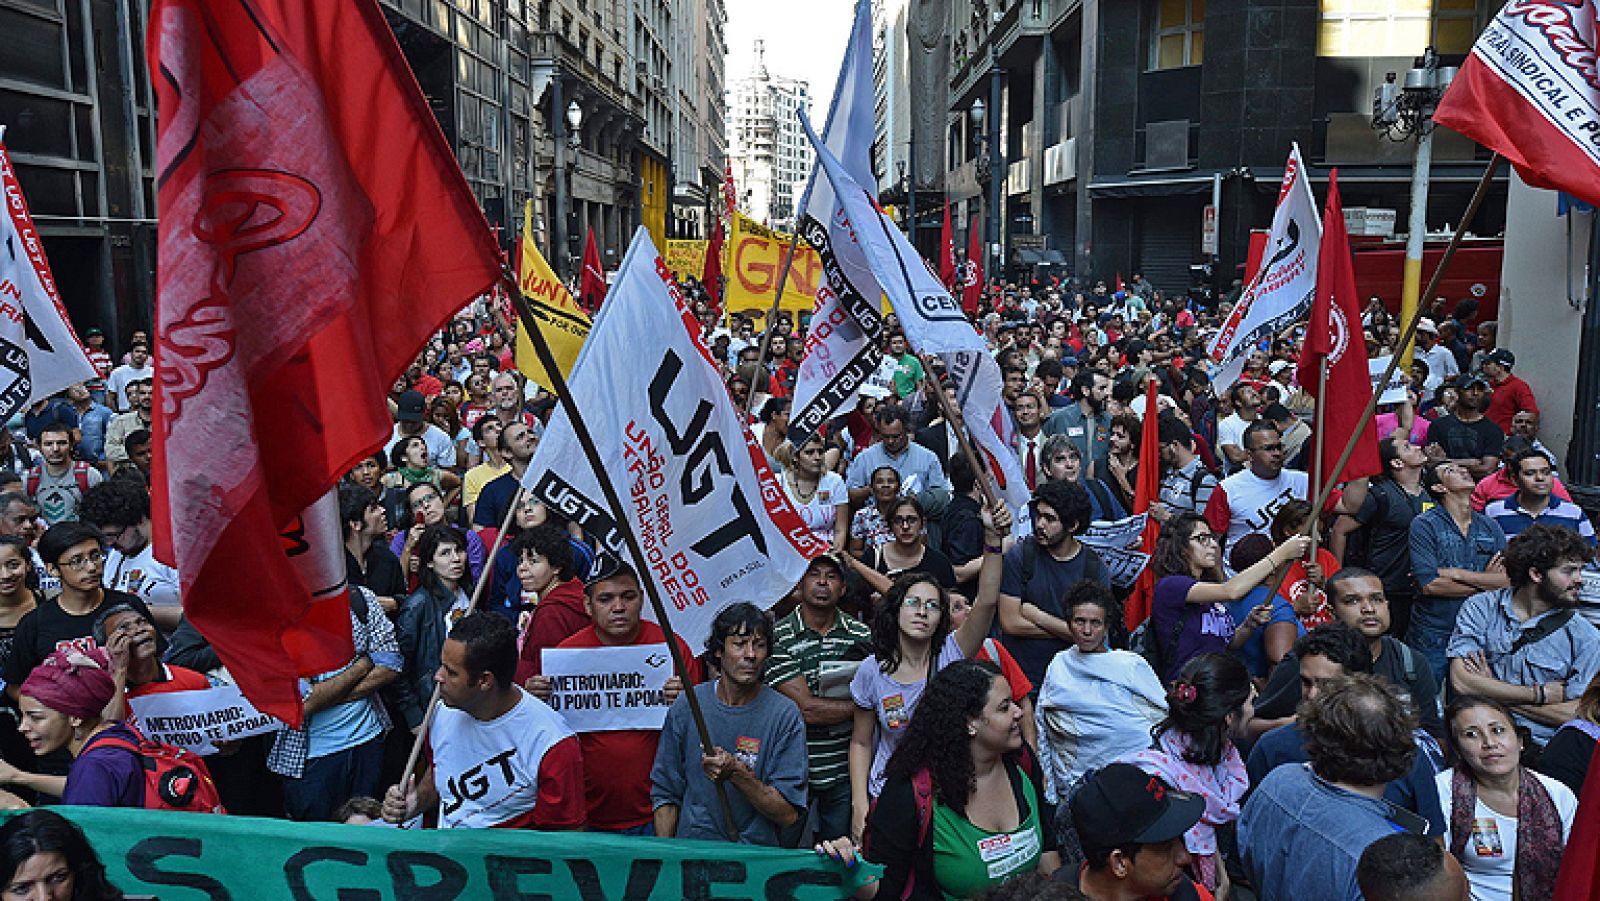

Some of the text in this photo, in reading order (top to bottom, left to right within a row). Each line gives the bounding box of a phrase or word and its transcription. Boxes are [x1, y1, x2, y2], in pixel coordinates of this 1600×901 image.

[1506, 47, 1570, 109] SINDICAL
[1565, 107, 1587, 122] E
[6, 184, 28, 223] UGT
[22, 228, 46, 267] UGT
[826, 258, 853, 299] UGT
[648, 347, 769, 559] UGT
[544, 480, 599, 525] UGT
[758, 466, 825, 556] UGT UGT
[655, 493, 674, 547] GERAL
[671, 551, 710, 608] DOS
[165, 731, 202, 746] POVO
[204, 727, 224, 739] TE
[551, 690, 669, 711] O POVO TE APOIA
